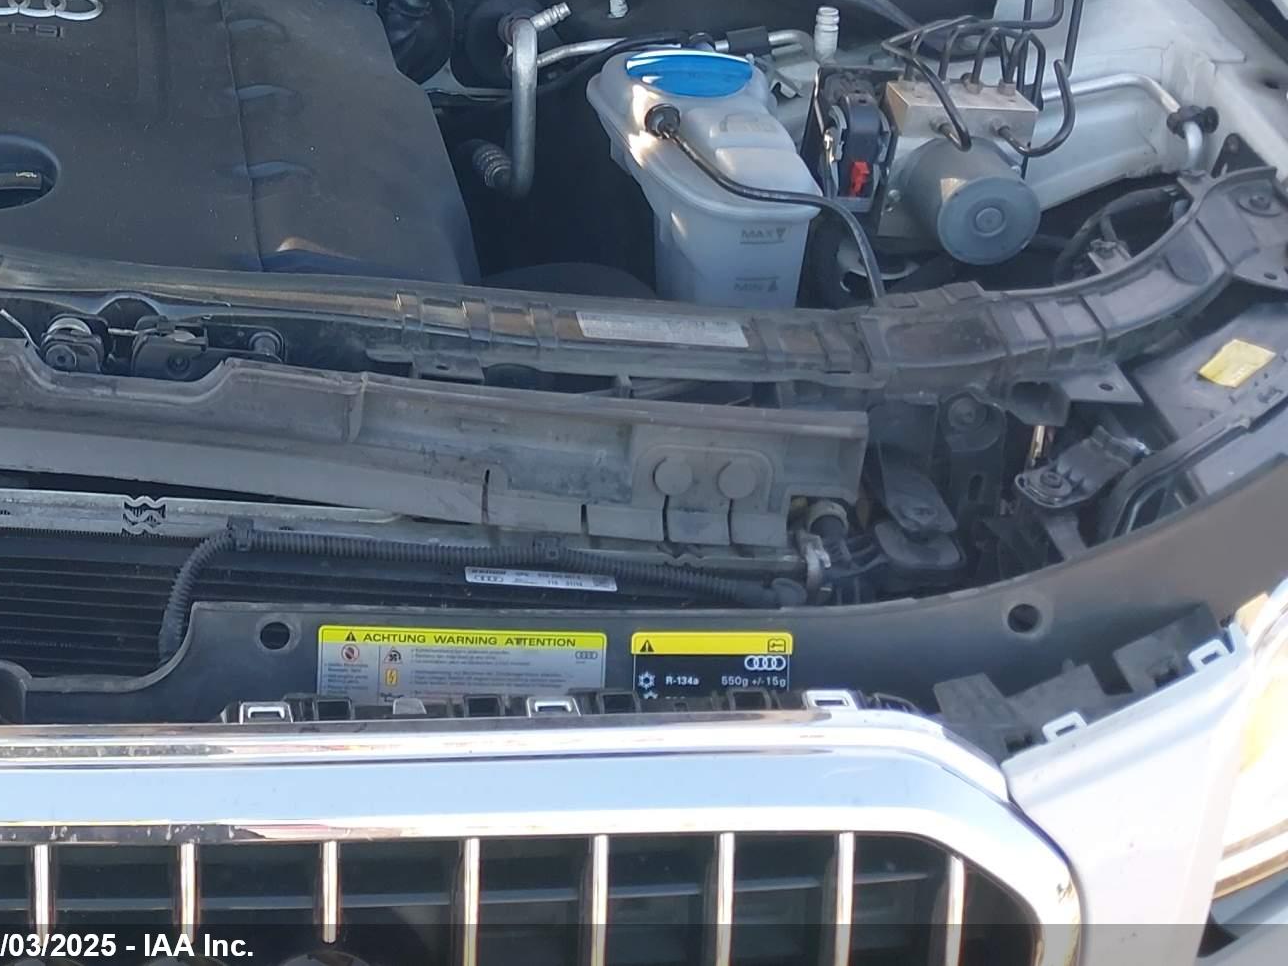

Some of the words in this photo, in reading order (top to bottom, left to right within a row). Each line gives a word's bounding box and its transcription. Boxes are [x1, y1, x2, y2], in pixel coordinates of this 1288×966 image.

[363, 633, 426, 644] ACHTUNG
[433, 635, 497, 646] WARNING
[504, 636, 576, 647] ATTENTION
[665, 675, 700, 686] R-134a
[722, 675, 749, 688] 550g
